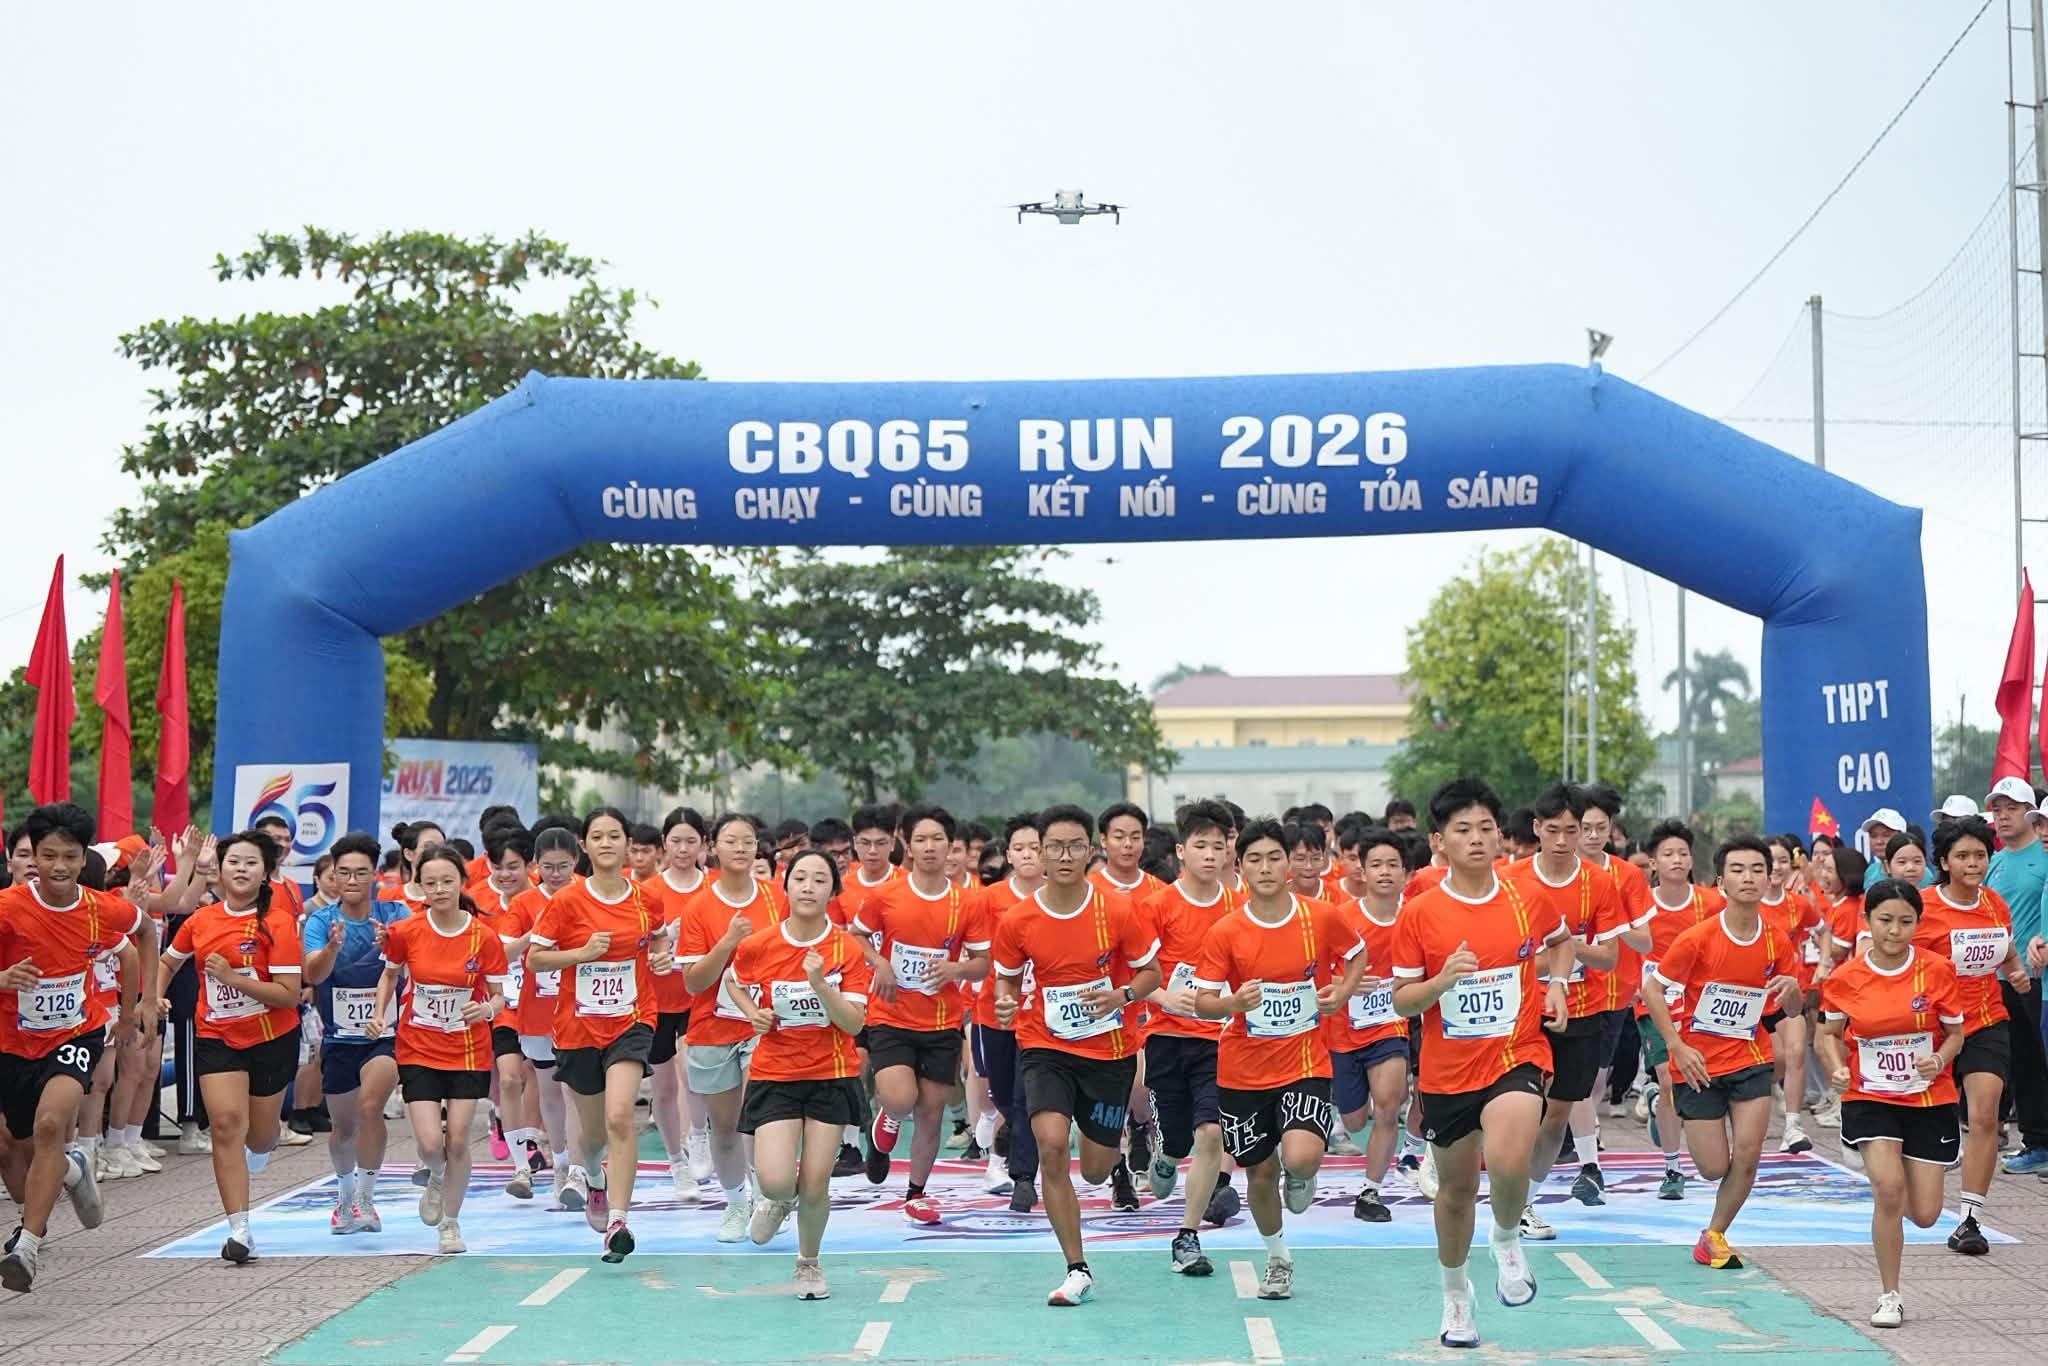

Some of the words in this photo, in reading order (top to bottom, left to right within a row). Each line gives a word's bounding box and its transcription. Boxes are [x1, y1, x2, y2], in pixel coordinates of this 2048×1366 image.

[729, 419, 969, 478] CBQ65
[1019, 417, 1173, 471] RUN
[1220, 412, 1408, 468] 2026
[602, 481, 697, 519] CÙNG
[735, 486, 820, 524] CHẠY
[890, 477, 983, 517] CÙNG
[1028, 474, 1089, 517] KẾT
[1120, 475, 1175, 517] NỐI
[1237, 477, 1327, 515] CÙNG
[1360, 467, 1422, 512] TỎA
[1447, 471, 1538, 509] SÁNG
[1822, 680, 1888, 724] THPT
[395, 760, 444, 795] RUN
[445, 765, 493, 795] 2026
[1838, 751, 1891, 794] CAO
[248, 768, 337, 855] 65
[1963, 944, 1995, 962] 2035
[592, 977, 624, 997] 2124
[774, 984, 788, 996] 65
[35, 992, 75, 1012] 2126
[790, 997, 820, 1011] 206
[1263, 997, 1301, 1018] 2029
[1362, 991, 1392, 1010] 2030
[1458, 989, 1504, 1014] 2075
[1710, 998, 1748, 1018] 2004
[348, 1003, 377, 1020] 212
[1060, 1002, 1097, 1021] 20
[57, 1044, 90, 1072] 38
[1876, 1051, 1916, 1072] 2001
